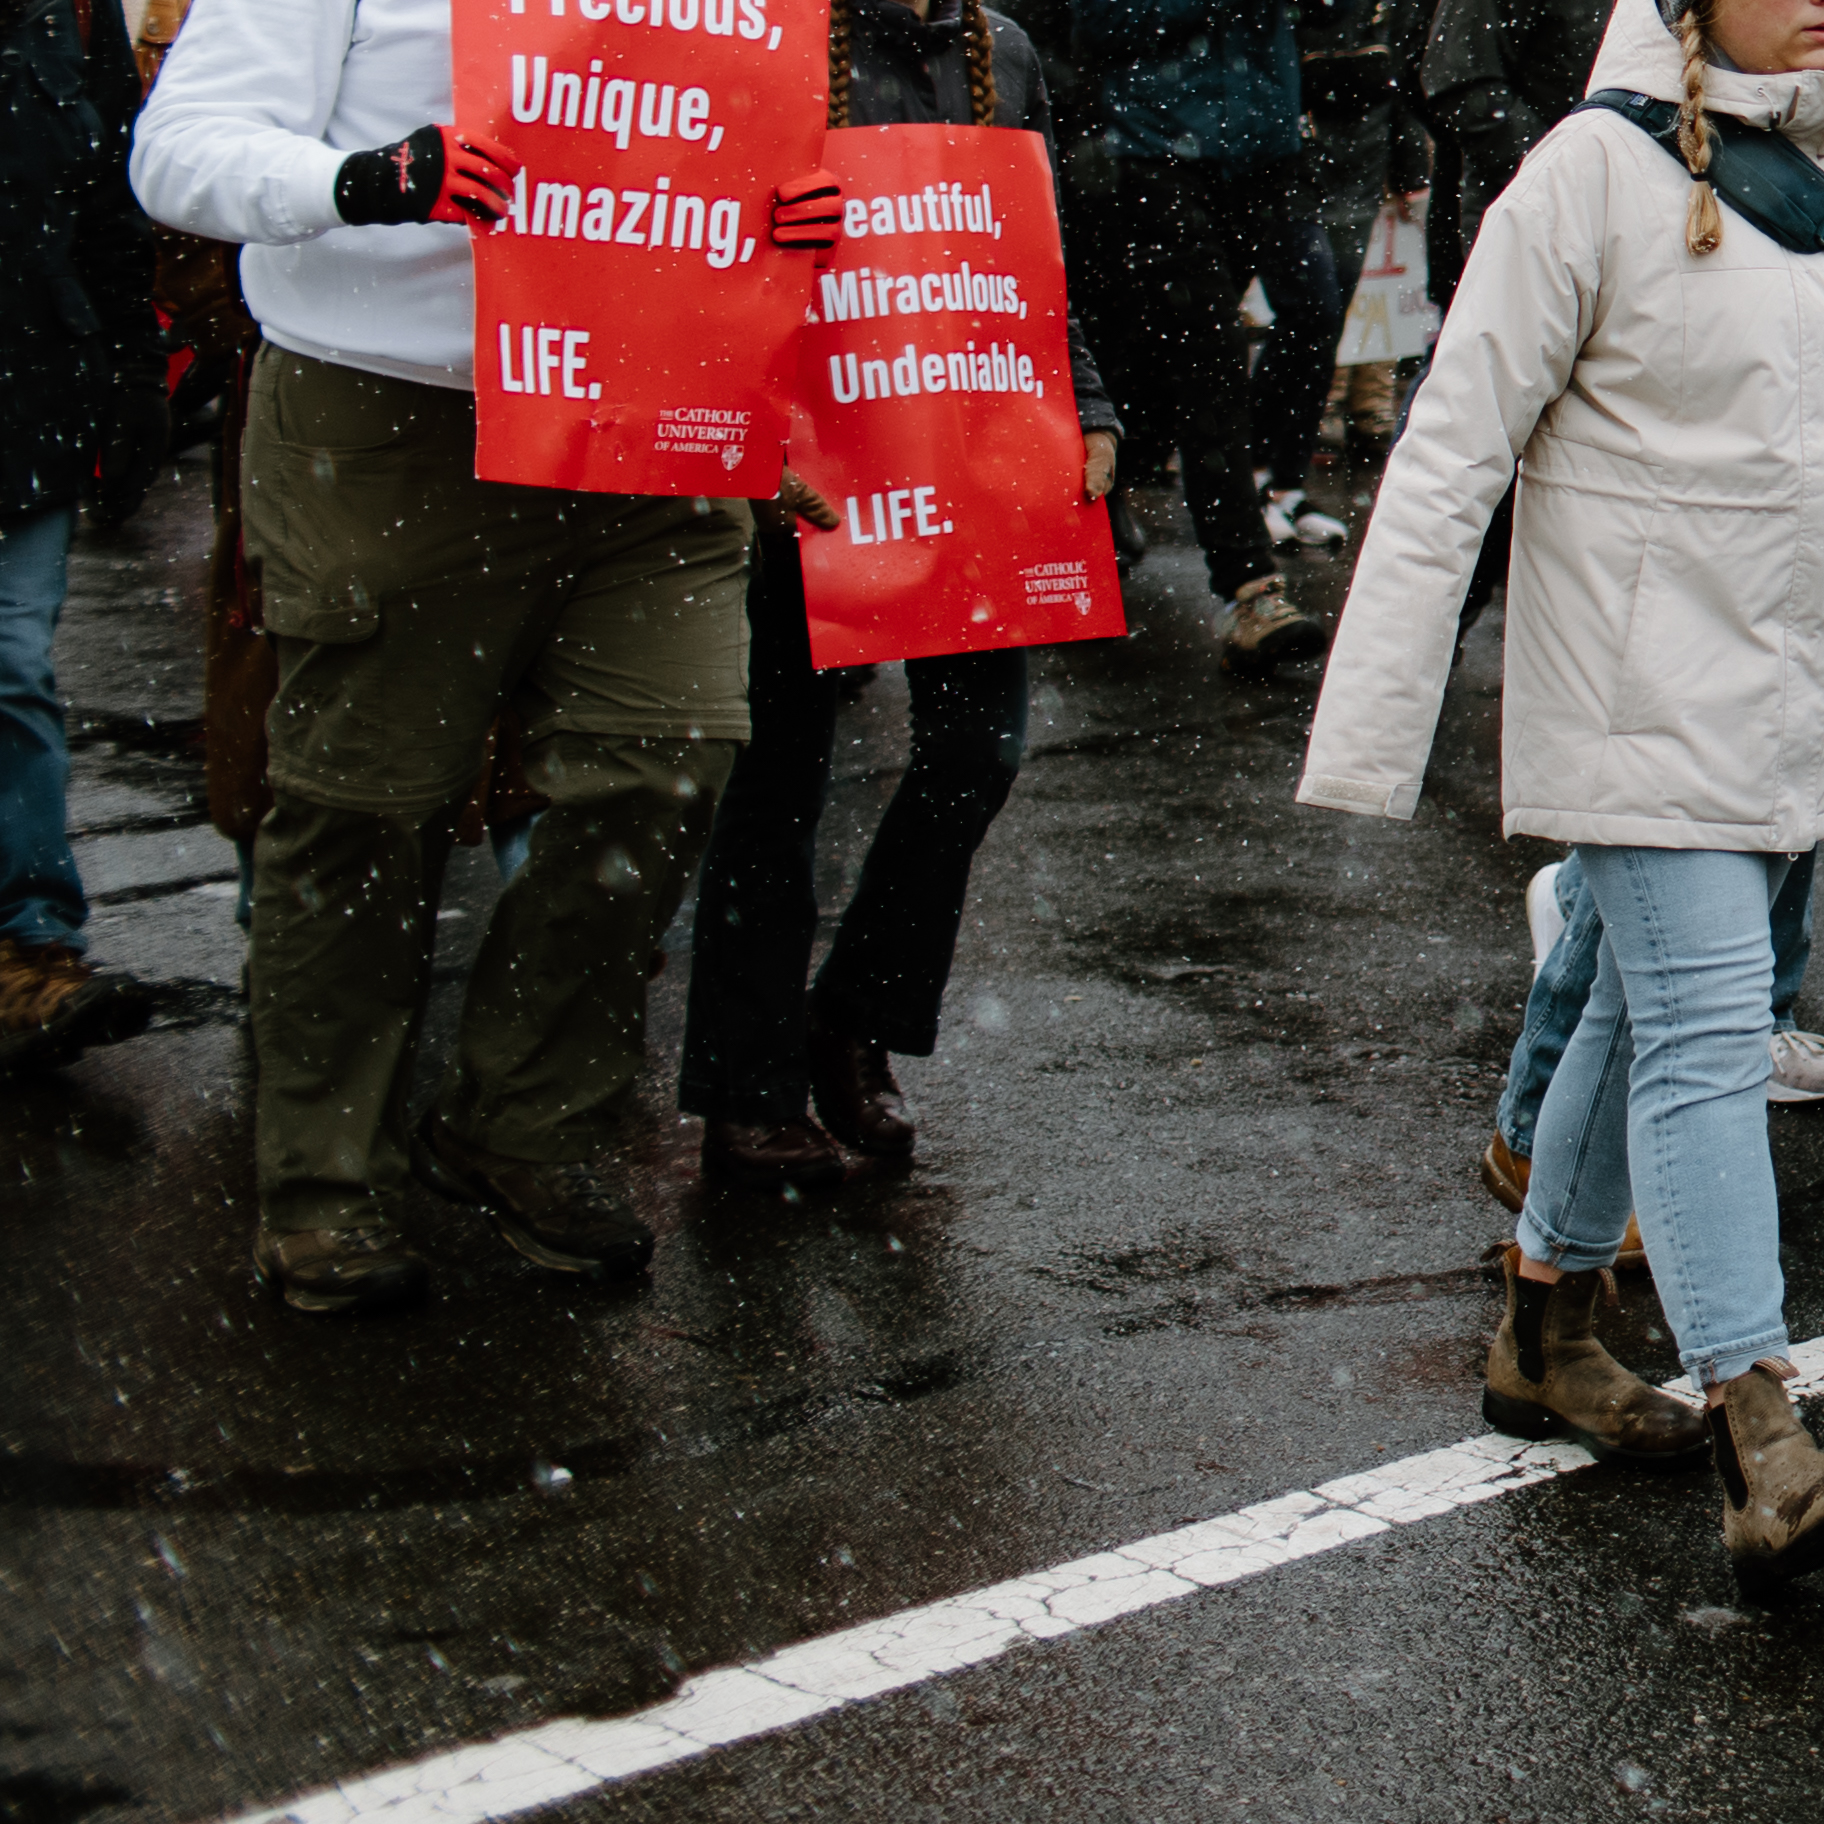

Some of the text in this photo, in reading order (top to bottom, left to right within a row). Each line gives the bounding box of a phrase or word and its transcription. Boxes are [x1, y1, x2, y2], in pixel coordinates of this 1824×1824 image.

[511, 54, 724, 150] Unique,
[495, 166, 755, 268] Amazing,
[844, 182, 1002, 239] eautiful,
[822, 262, 1027, 323] Miraculous,
[500, 324, 601, 400] LIFE.
[829, 343, 1044, 404] Undeniable,
[657, 423, 749, 442] UNIVERSITY
[674, 407, 751, 425] CATHOLIC
[654, 440, 719, 453] OF AMERICA
[847, 485, 953, 545] LIFE.
[1025, 575, 1088, 593] UNIVERSITY
[1034, 560, 1087, 577] CATHOLIC
